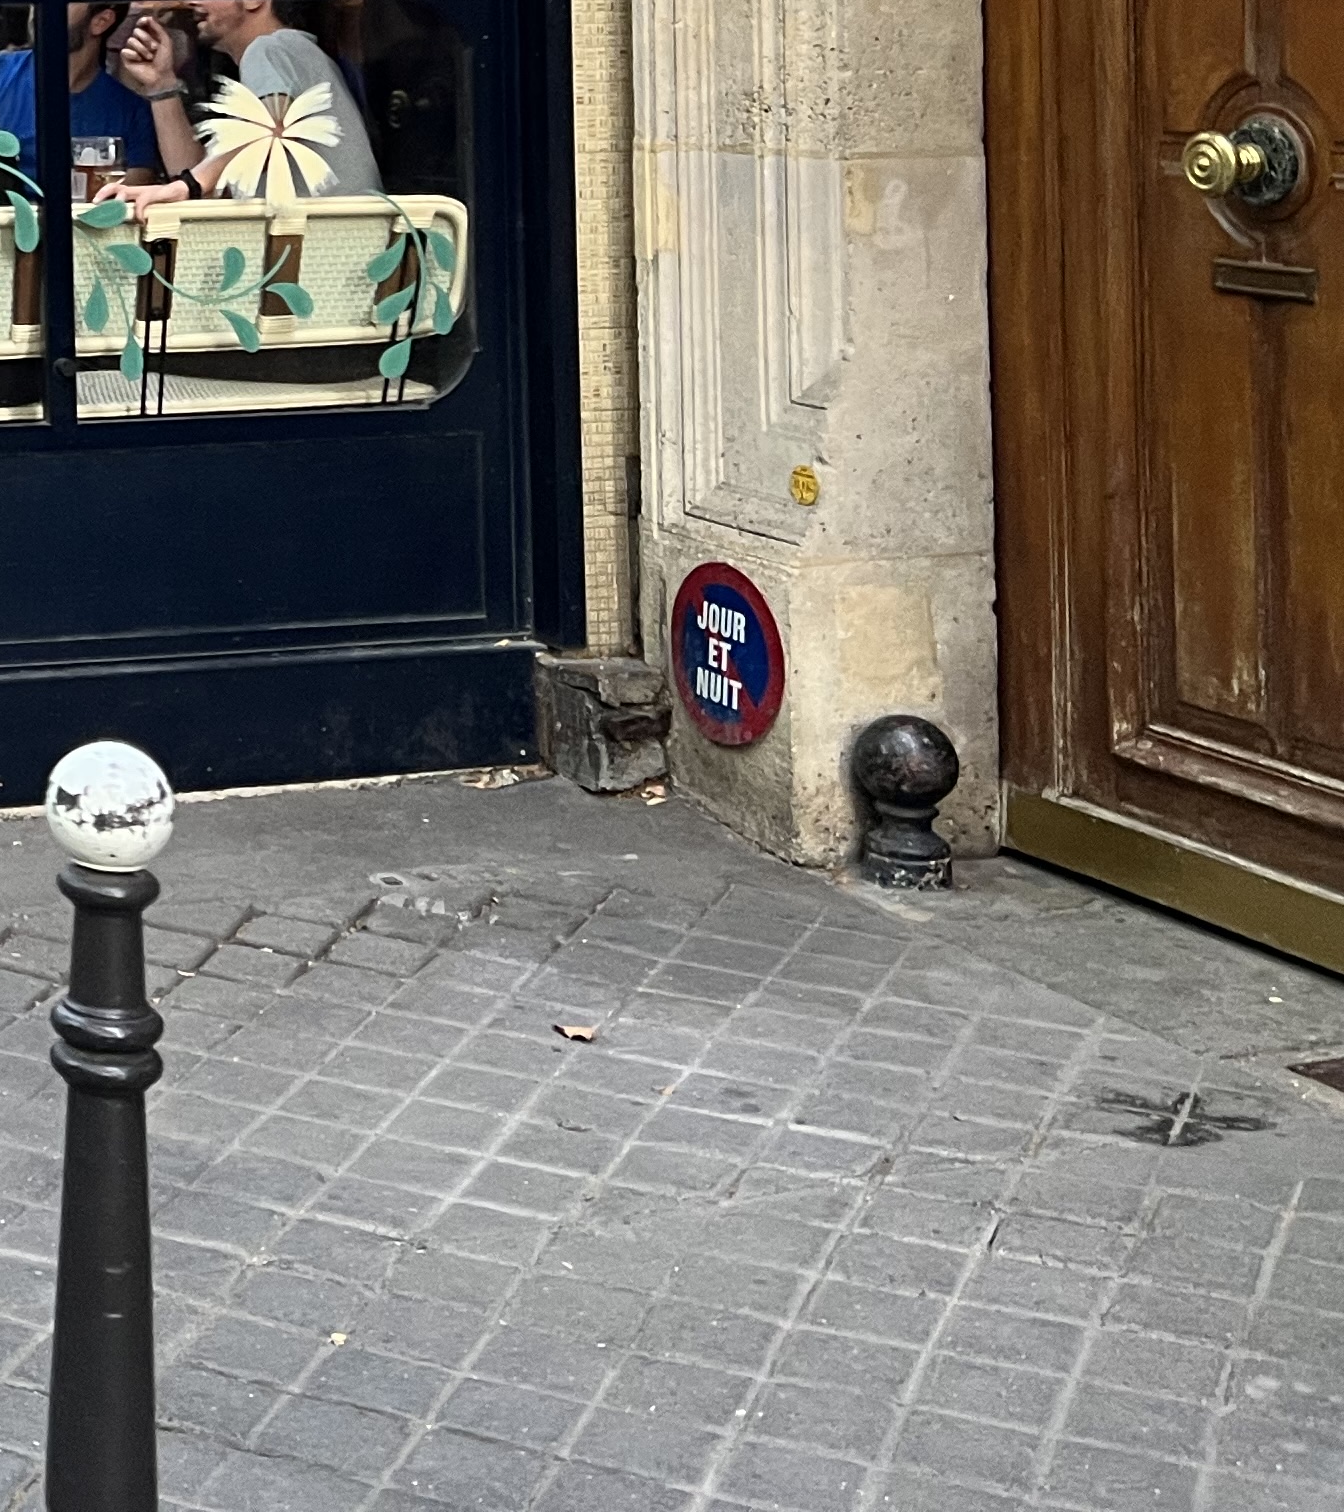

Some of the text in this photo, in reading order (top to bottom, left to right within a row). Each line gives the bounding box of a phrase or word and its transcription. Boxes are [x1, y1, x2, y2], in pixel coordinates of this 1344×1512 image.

[696, 600, 746, 643] JOUR
[708, 637, 732, 672] ET
[696, 666, 743, 711] NUIT
